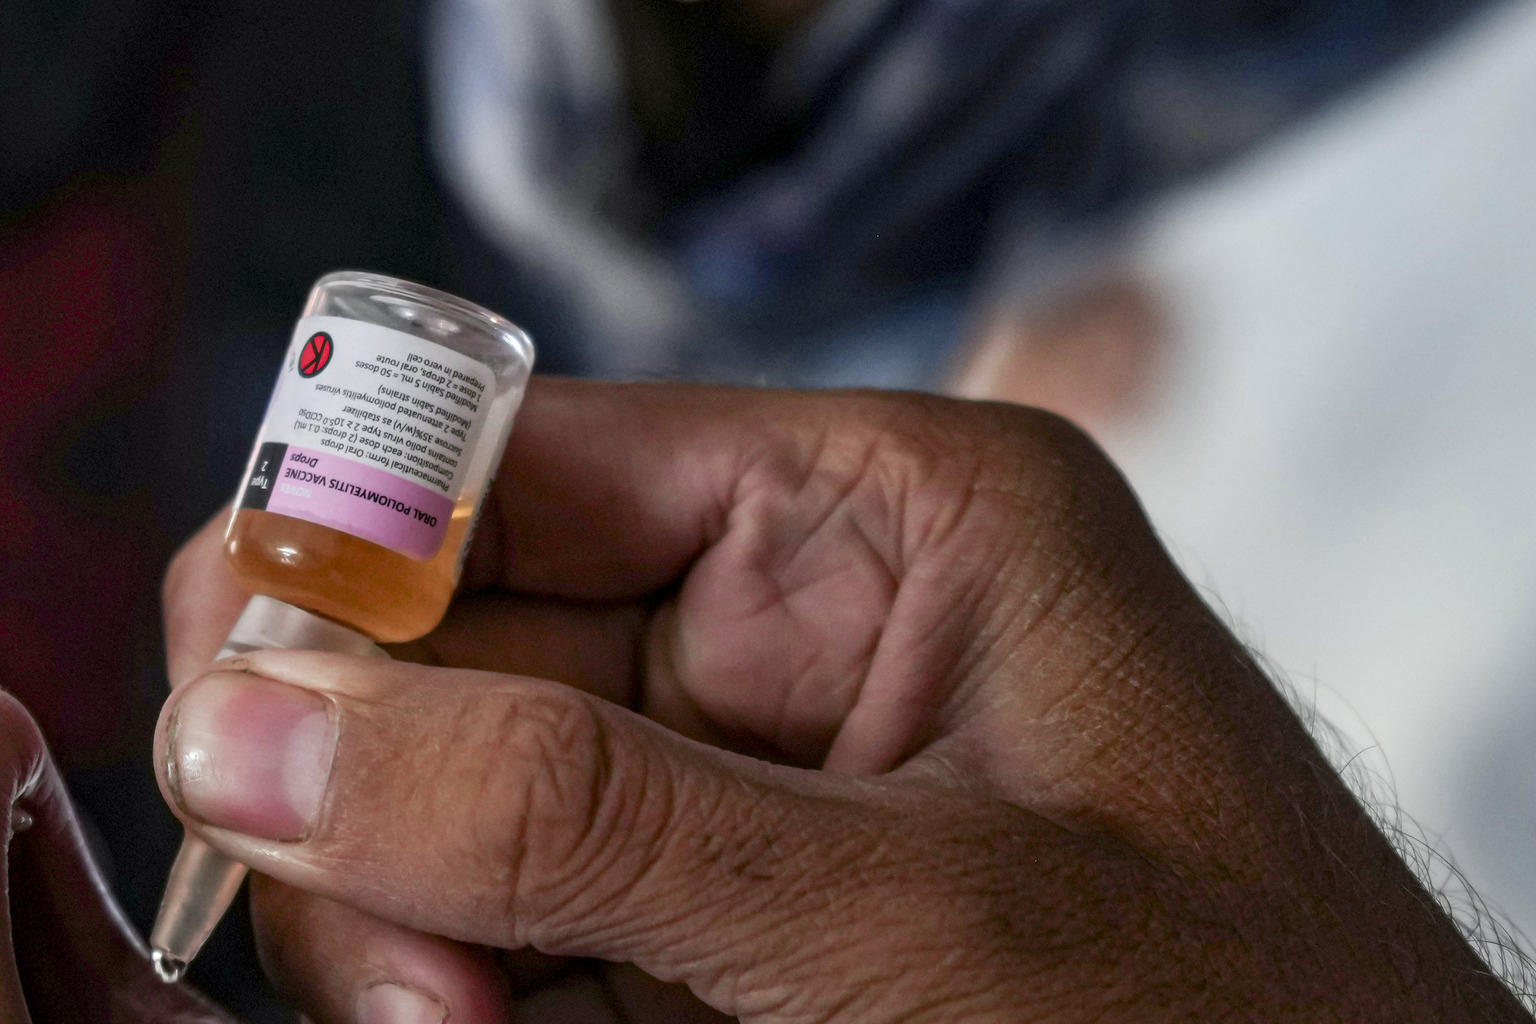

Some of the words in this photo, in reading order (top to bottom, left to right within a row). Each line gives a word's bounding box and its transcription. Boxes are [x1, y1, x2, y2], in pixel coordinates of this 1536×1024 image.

[377, 355, 399, 367] route
[407, 353, 423, 363] cell
[356, 361, 379, 373] doses
[400, 363, 418, 373] oral
[424, 359, 442, 371] vero
[444, 367, 452, 376] in
[380, 368, 392, 377] 50
[401, 374, 413, 383] mL
[421, 368, 445, 384] drops,
[452, 371, 485, 392] Prepared
[315, 384, 340, 395] viruses
[378, 385, 410, 401] strains)
[422, 382, 445, 397] Sabin
[459, 386, 476, 399] dose
[343, 390, 397, 410] poliomyelitis
[412, 397, 435, 413] Sabin
[445, 391, 478, 412] Modified
[342, 406, 381, 422] stabilizer
[397, 406, 443, 428] attenuated
[435, 407, 471, 429] (Modified
[294, 420, 307, 429] mL)
[309, 424, 320, 433] 0.1
[362, 425, 381, 437] type
[322, 427, 347, 439] drops:
[348, 433, 358, 443] (2
[383, 432, 403, 444] virus
[393, 420, 433, 443] 35%(w/v)
[451, 428, 466, 442] Type
[321, 439, 344, 451] drops
[359, 437, 380, 449] dose
[406, 440, 427, 453] polio
[434, 437, 462, 456] Sucrose
[345, 446, 364, 457] Oral
[382, 445, 402, 456] each
[290, 453, 318, 468] Drops
[366, 452, 389, 467] form:
[428, 449, 457, 467] contains
[404, 452, 453, 480] Composition:
[251, 476, 267, 489] Type
[285, 468, 326, 486] VACCINE
[391, 461, 449, 491] Pharmaceutical
[282, 483, 312, 499] NOVEL
[329, 479, 411, 515] POLIOMYELITIS
[414, 508, 437, 527] ORAL
